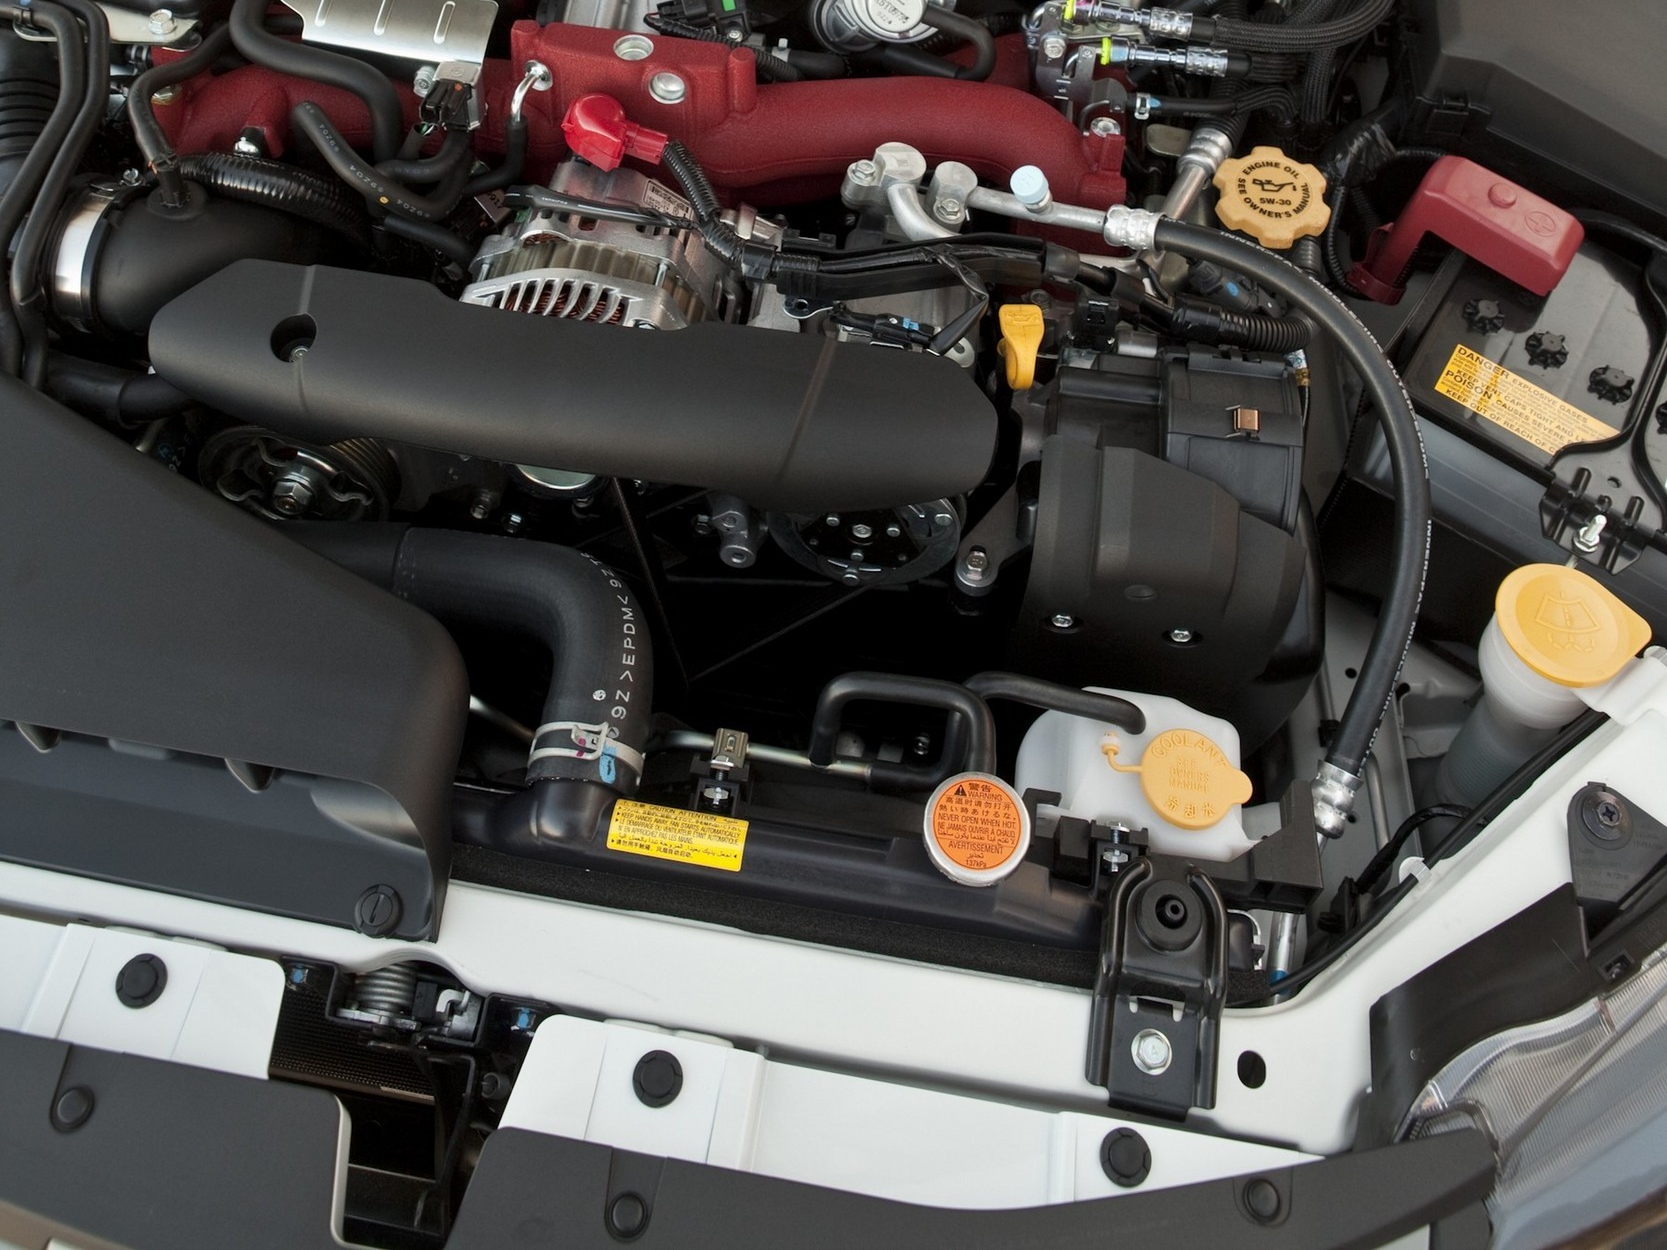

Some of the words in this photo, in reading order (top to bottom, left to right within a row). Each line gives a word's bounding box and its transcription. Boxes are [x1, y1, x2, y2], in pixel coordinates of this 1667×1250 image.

[1242, 161, 1280, 175] ENGINE
[1283, 166, 1300, 179] OIL
[1238, 178, 1247, 195] SEE
[1243, 197, 1292, 218] OWNER'S
[1293, 183, 1310, 214] MANUAL
[1457, 347, 1510, 379] DANGER
[1512, 378, 1558, 405] EXPLOSIVE
[1559, 404, 1588, 424] GASES
[1445, 370, 1493, 400] POISON
[1496, 399, 1530, 421] CAUSES
[1532, 419, 1566, 440] SEVERE
[1456, 369, 1479, 384] KEEP
[1481, 381, 1502, 397] VENT
[1503, 395, 1527, 410] CAPS
[1529, 409, 1553, 425] TIGHT
[1555, 424, 1574, 437] AND
[1446, 389, 1469, 403] KEEP
[1470, 402, 1488, 414] OUT
[1489, 413, 1502, 422] OF
[1503, 421, 1533, 440] REACH
[1534, 438, 1547, 448] OF
[1151, 731, 1226, 768] COOLANT
[1178, 758, 1197, 767] SEE
[969, 783, 992, 792] 警告
[1169, 776, 1207, 793] MANUAL
[968, 791, 1003, 802] WARNING
[649, 804, 675, 814] CAUTION
[679, 809, 717, 821] ATTENTION
[622, 812, 633, 821] KEEP
[635, 814, 652, 823] HANDS
[670, 820, 679, 828] FAN
[681, 821, 700, 830] STARTS
[939, 813, 959, 823] NEVER
[961, 816, 979, 825] OPEN
[980, 819, 1000, 827] WHEN
[938, 822, 945, 830] NE
[947, 823, 967, 831] JAMAIS
[969, 825, 990, 834] OUVRIR
[660, 832, 668, 840] PAS
[948, 840, 1003, 854] AVERTISSEMENT
[966, 859, 987, 868] 137kPa
